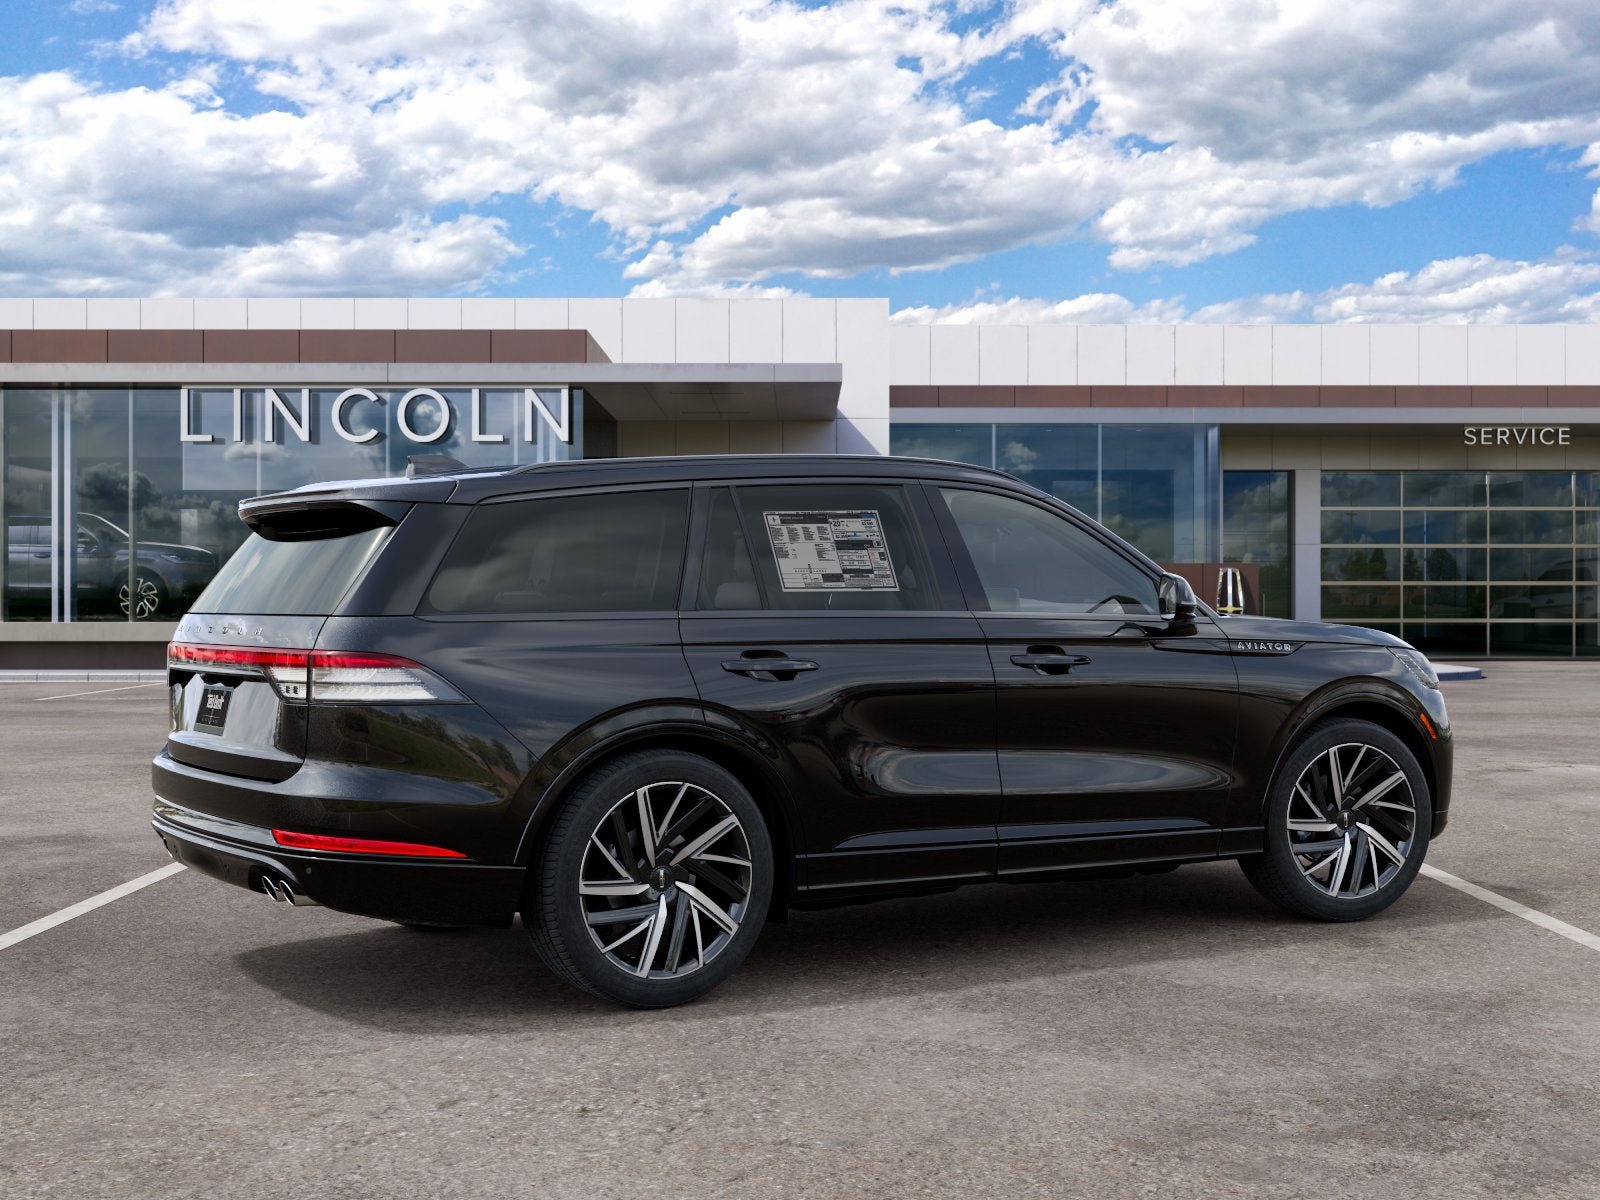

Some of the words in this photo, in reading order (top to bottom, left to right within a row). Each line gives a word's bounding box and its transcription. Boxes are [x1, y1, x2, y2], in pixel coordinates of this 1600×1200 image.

[180, 387, 569, 443] LINCOLN
[1464, 427, 1571, 445] SERVICE
[1237, 641, 1291, 651] AVIATOR
